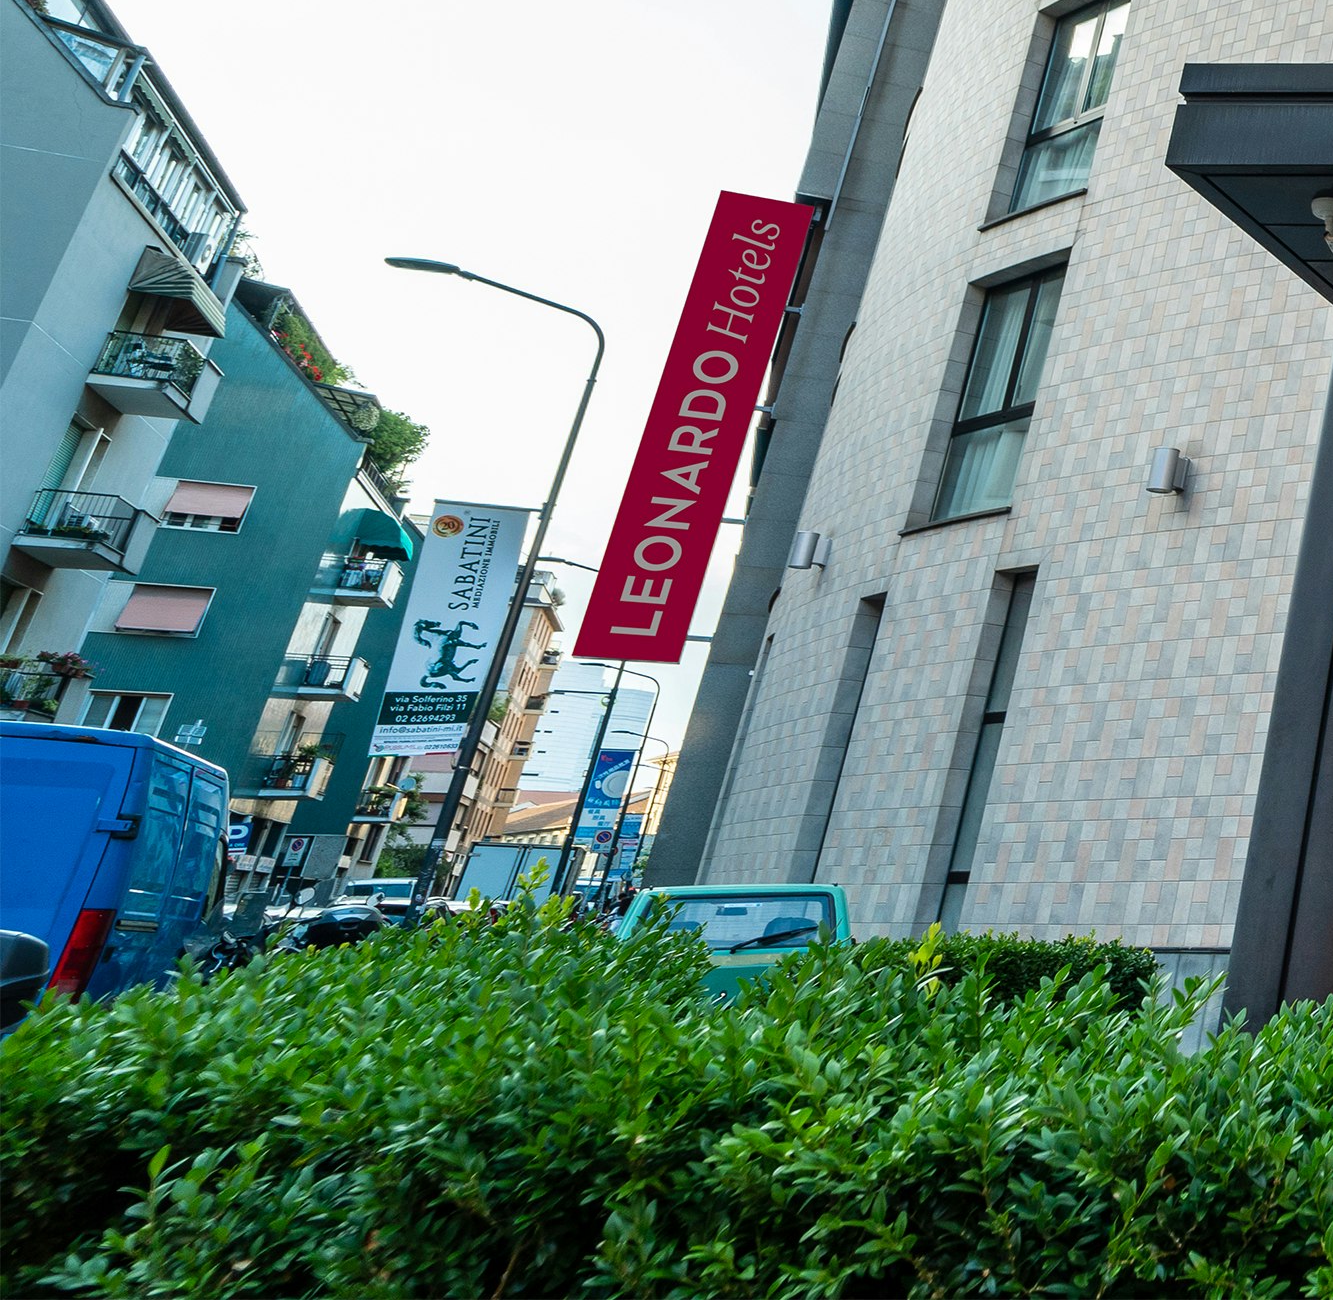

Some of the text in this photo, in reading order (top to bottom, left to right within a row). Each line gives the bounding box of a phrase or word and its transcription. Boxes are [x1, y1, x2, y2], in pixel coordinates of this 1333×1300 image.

[610, 218, 781, 637] LEONARDO Hotels
[448, 517, 491, 610] SABATINI
[472, 559, 490, 608] MEDIAZIONE
[412, 695, 454, 703] Solferino
[407, 704, 433, 712] Fabio
[435, 703, 454, 711] Filzi
[456, 703, 466, 711] 11
[410, 714, 456, 722] 62694293
[380, 725, 462, 734] info@sabatini-mi.it
